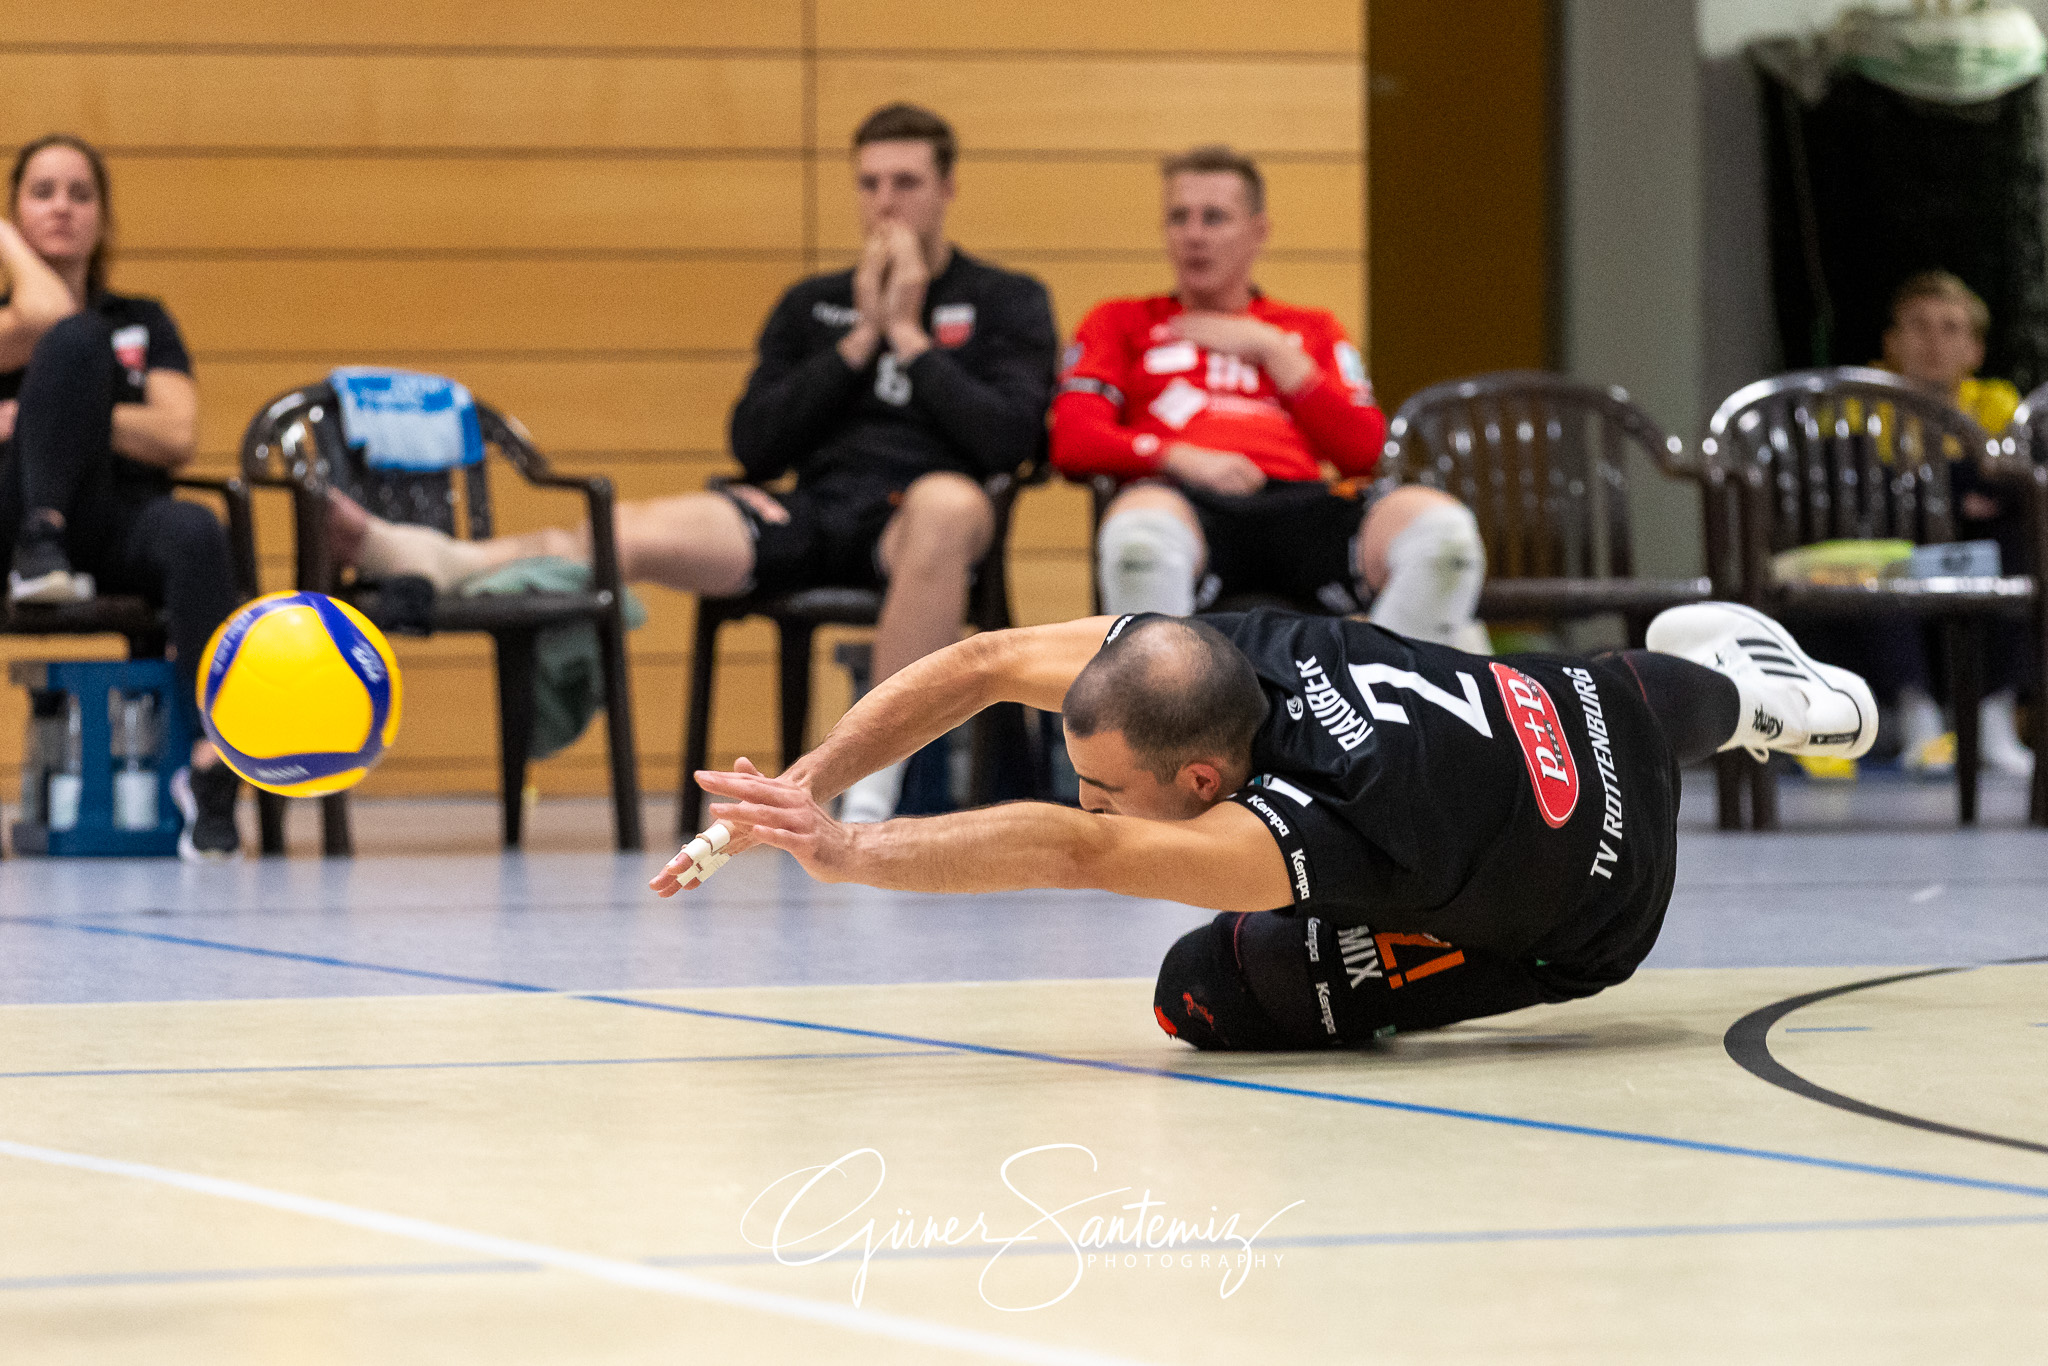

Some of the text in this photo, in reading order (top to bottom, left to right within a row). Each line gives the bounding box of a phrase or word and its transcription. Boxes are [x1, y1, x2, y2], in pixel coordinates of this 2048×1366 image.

[1347, 662, 1494, 740] 2
[1562, 666, 1623, 880] TV ROTTENBURG
[1246, 794, 1291, 839] Kempa
[1290, 848, 1311, 900] Kempa
[1336, 924, 1384, 990] MIX
[1315, 980, 1337, 1036] Kempa
